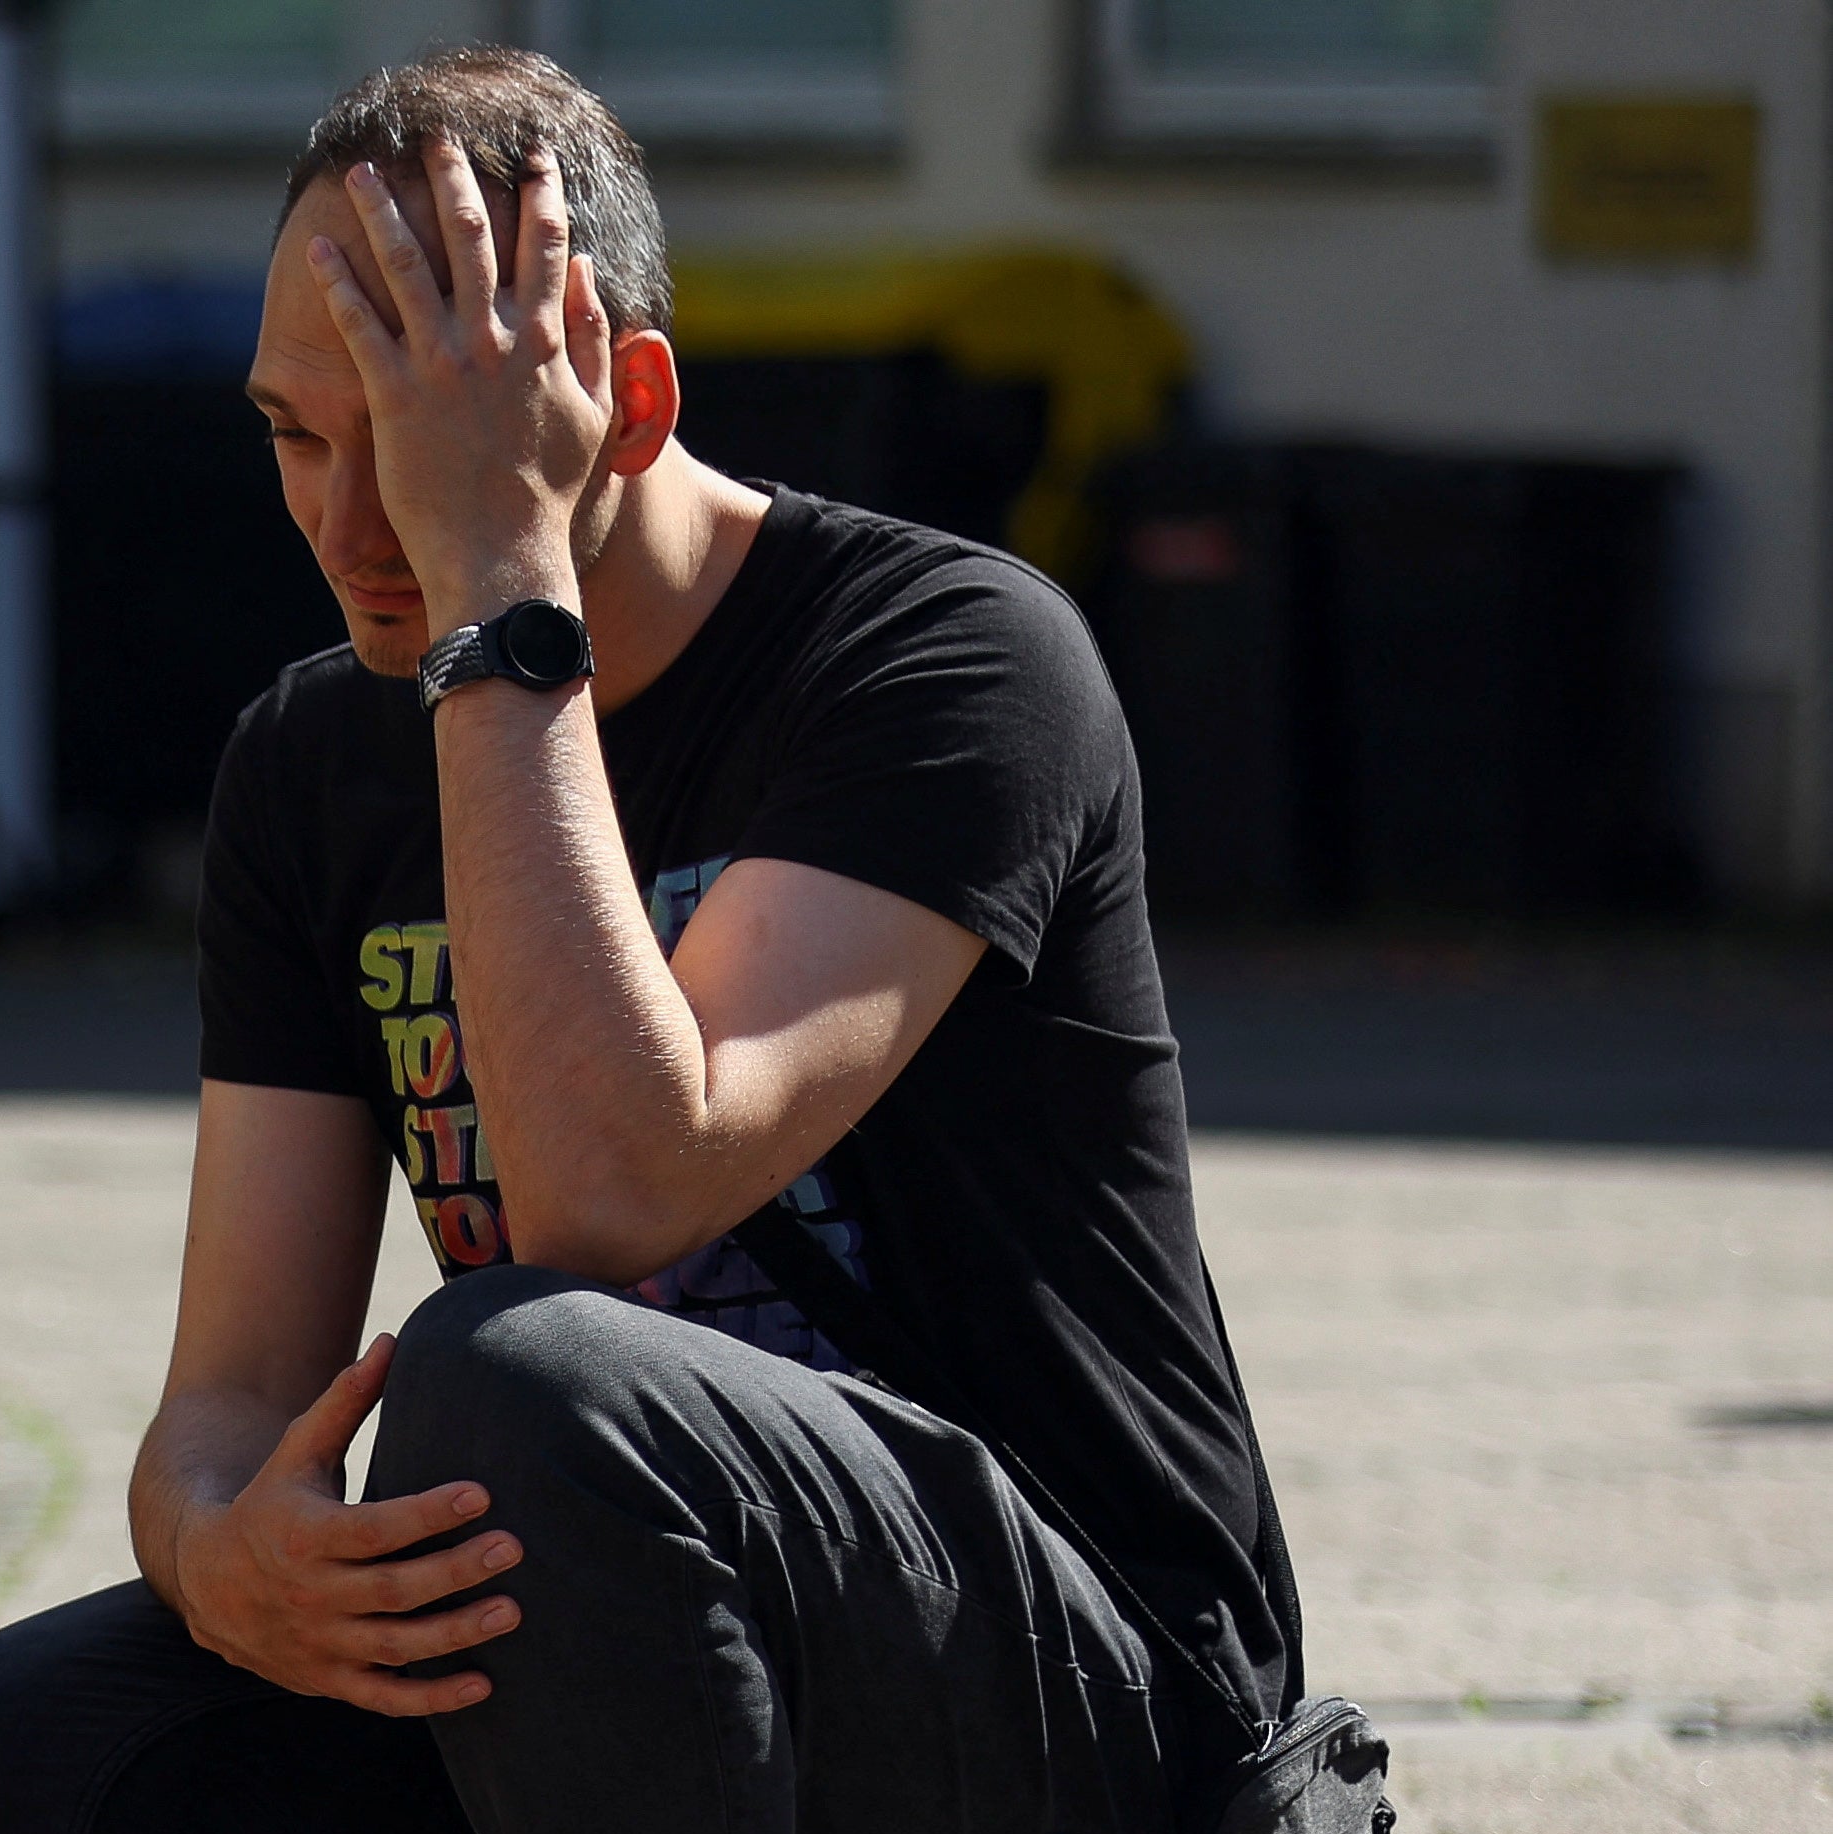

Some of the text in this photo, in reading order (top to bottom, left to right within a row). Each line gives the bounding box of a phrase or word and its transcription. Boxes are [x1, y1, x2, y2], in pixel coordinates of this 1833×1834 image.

[359, 922, 455, 1011] ST
[381, 1013, 467, 1098] TO
[403, 1104, 496, 1186] ST
[419, 1194, 507, 1266] TO
